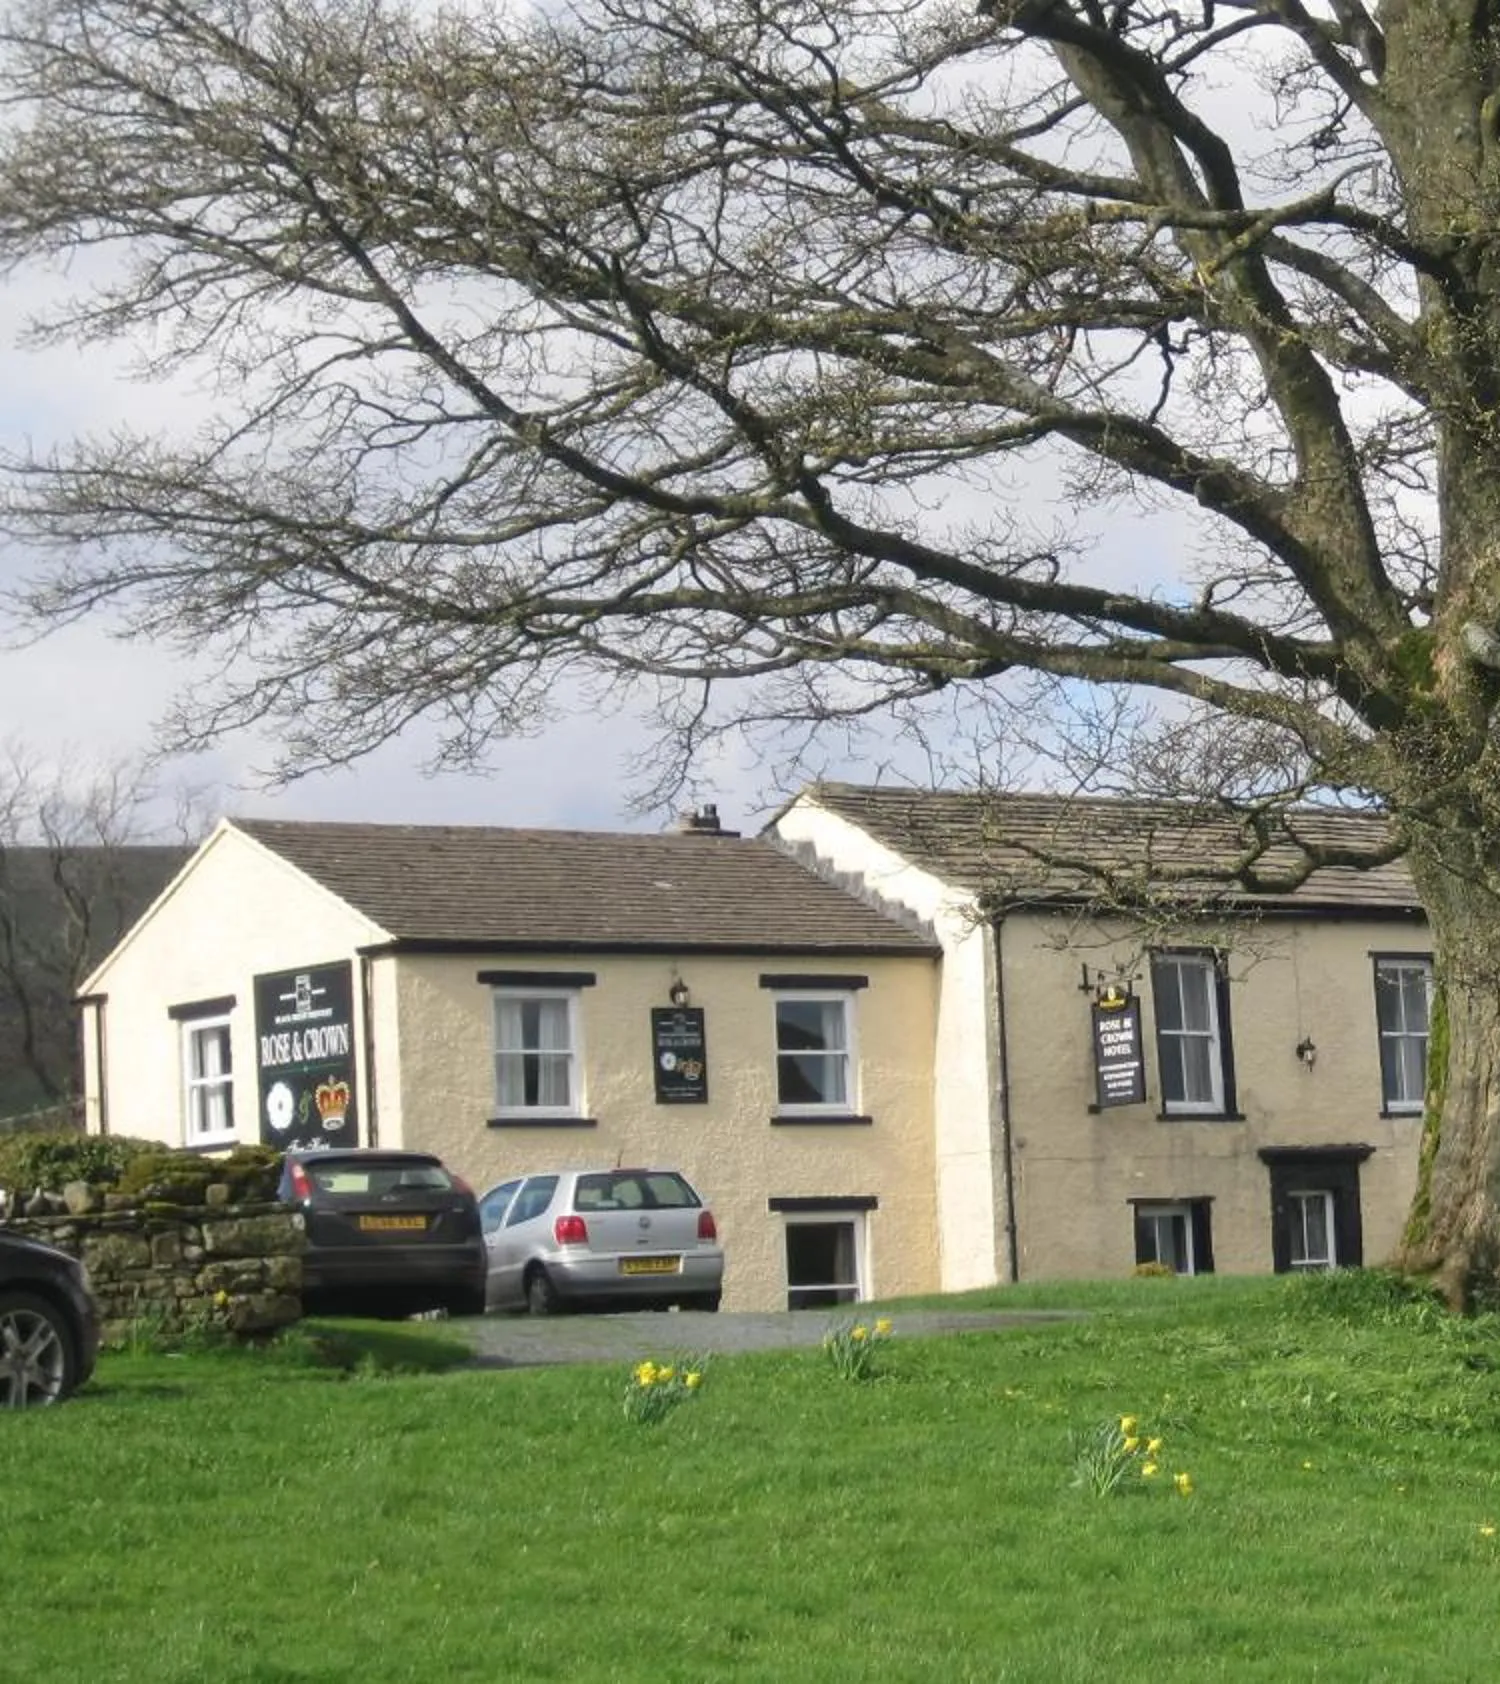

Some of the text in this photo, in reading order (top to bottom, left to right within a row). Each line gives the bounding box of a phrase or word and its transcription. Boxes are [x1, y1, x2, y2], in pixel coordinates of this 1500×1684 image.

[1100, 1019, 1121, 1032] ROSE
[1101, 1030, 1133, 1045] CROWN
[261, 1023, 349, 1067] ROSE & CROWN
[1103, 1043, 1132, 1057] HOTEL
